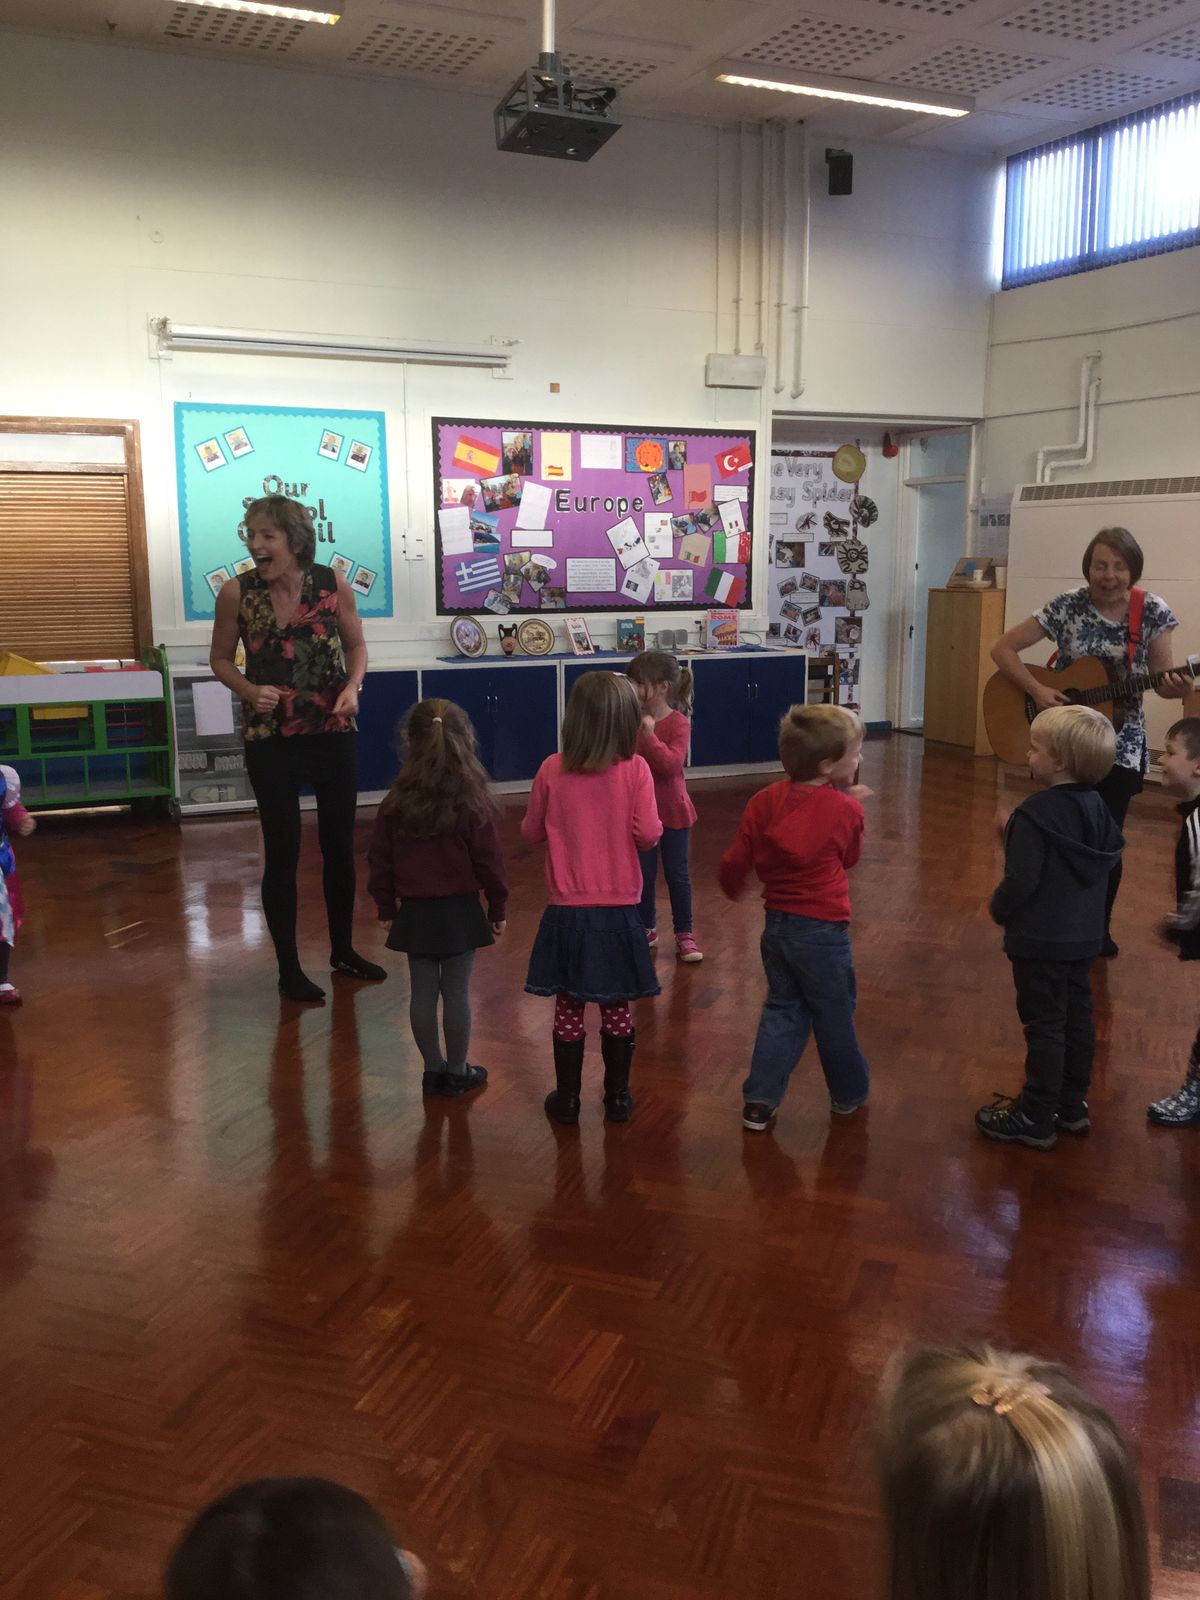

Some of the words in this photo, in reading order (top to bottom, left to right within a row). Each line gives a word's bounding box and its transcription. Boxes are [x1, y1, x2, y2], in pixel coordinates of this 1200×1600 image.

[784, 456, 823, 483] Very
[263, 474, 309, 497] Our
[802, 480, 852, 508] Spider
[555, 489, 644, 519] Europe
